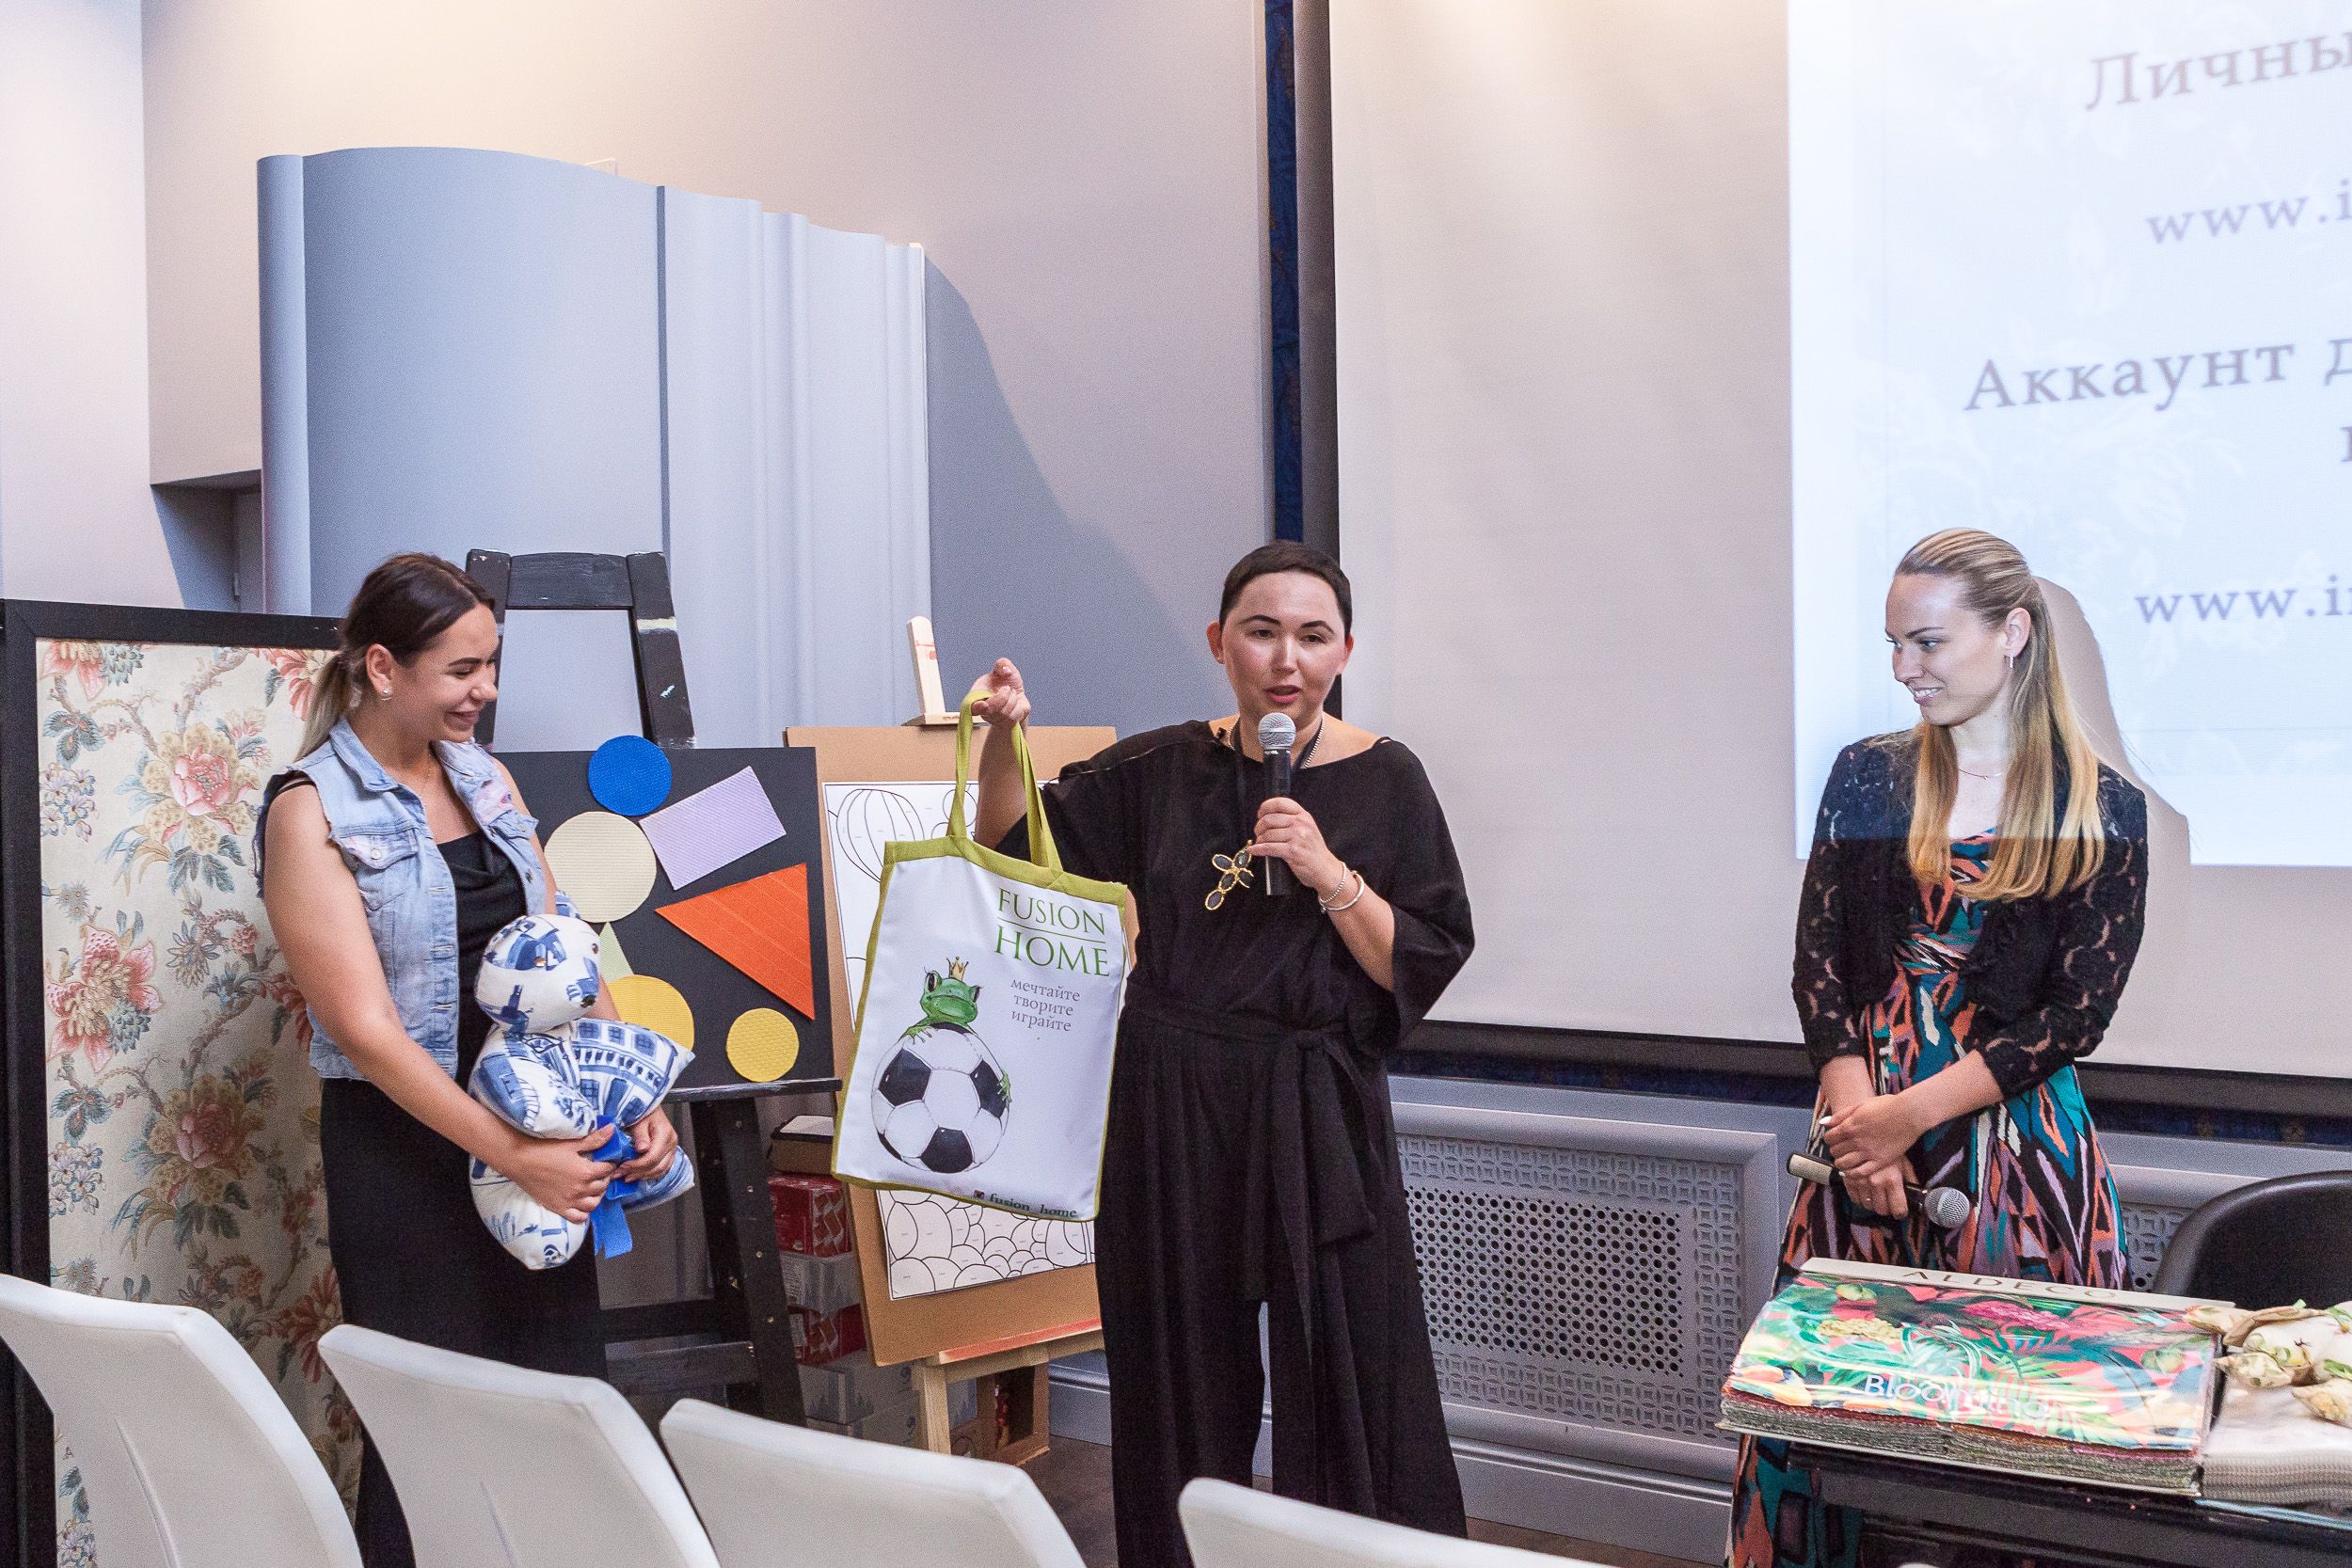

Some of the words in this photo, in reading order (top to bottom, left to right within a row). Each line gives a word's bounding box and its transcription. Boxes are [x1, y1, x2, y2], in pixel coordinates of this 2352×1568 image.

[1963, 343, 2296, 411] Аккаунт
[2133, 574, 2352, 625] www.i
[997, 887, 1105, 936] FUSION
[994, 925, 1110, 977] HOME
[1010, 978, 1081, 1002] мечтайте
[1013, 994, 1074, 1016] творите
[1011, 1010, 1073, 1032] играйте
[1903, 1270, 2117, 1299] ALDECO
